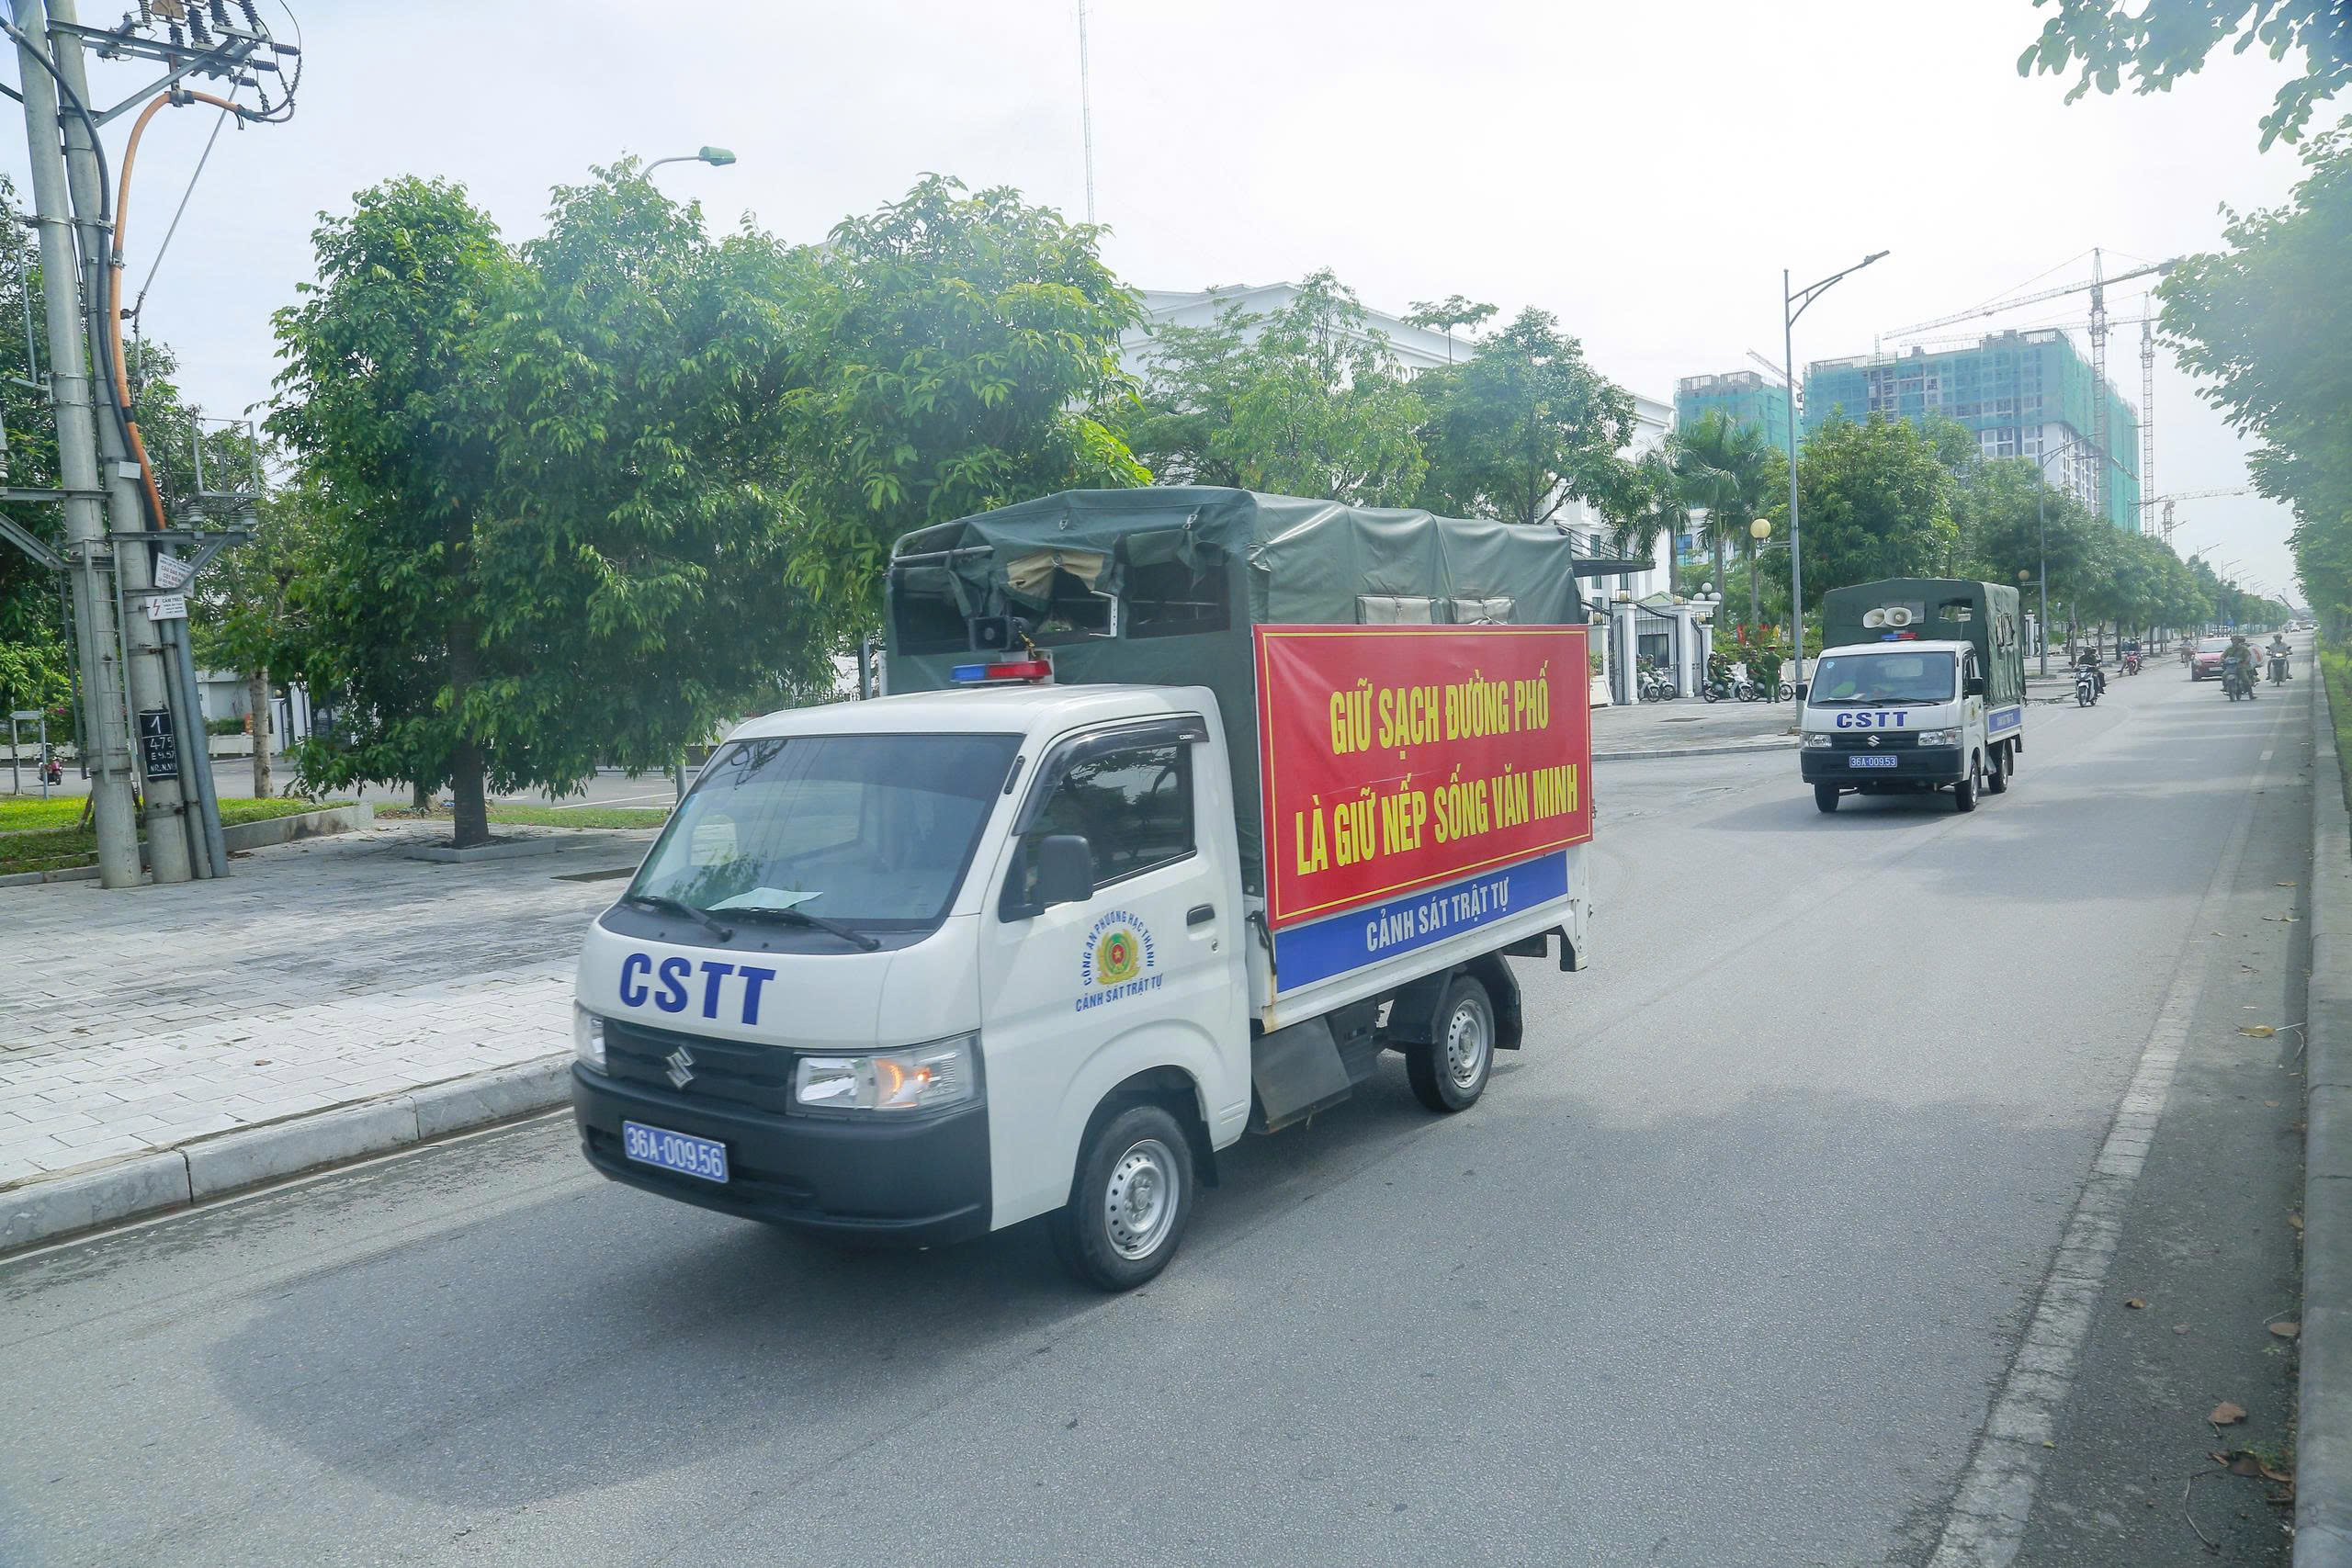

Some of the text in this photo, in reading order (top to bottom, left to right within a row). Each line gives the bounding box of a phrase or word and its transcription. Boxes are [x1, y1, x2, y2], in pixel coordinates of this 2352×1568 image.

[151, 716, 162, 734] 1
[1329, 660, 1549, 760] GIỮ SẠCH ĐƯỜNG PHỐ
[1837, 711, 1908, 728] CSTT
[150, 737, 173, 750] 475
[1295, 763, 1578, 875] LÀ GIỮ NẾP SỐNG VĂN MINH
[1366, 876, 1510, 953] CẢNH SÁT TRẬT TỰ
[1086, 932, 1097, 950] AN
[619, 952, 776, 1026] CSTT
[1075, 973, 1163, 1012] CẢNH SÁT TRẬT TỰ
[627, 1126, 723, 1177] 36A-009.56
